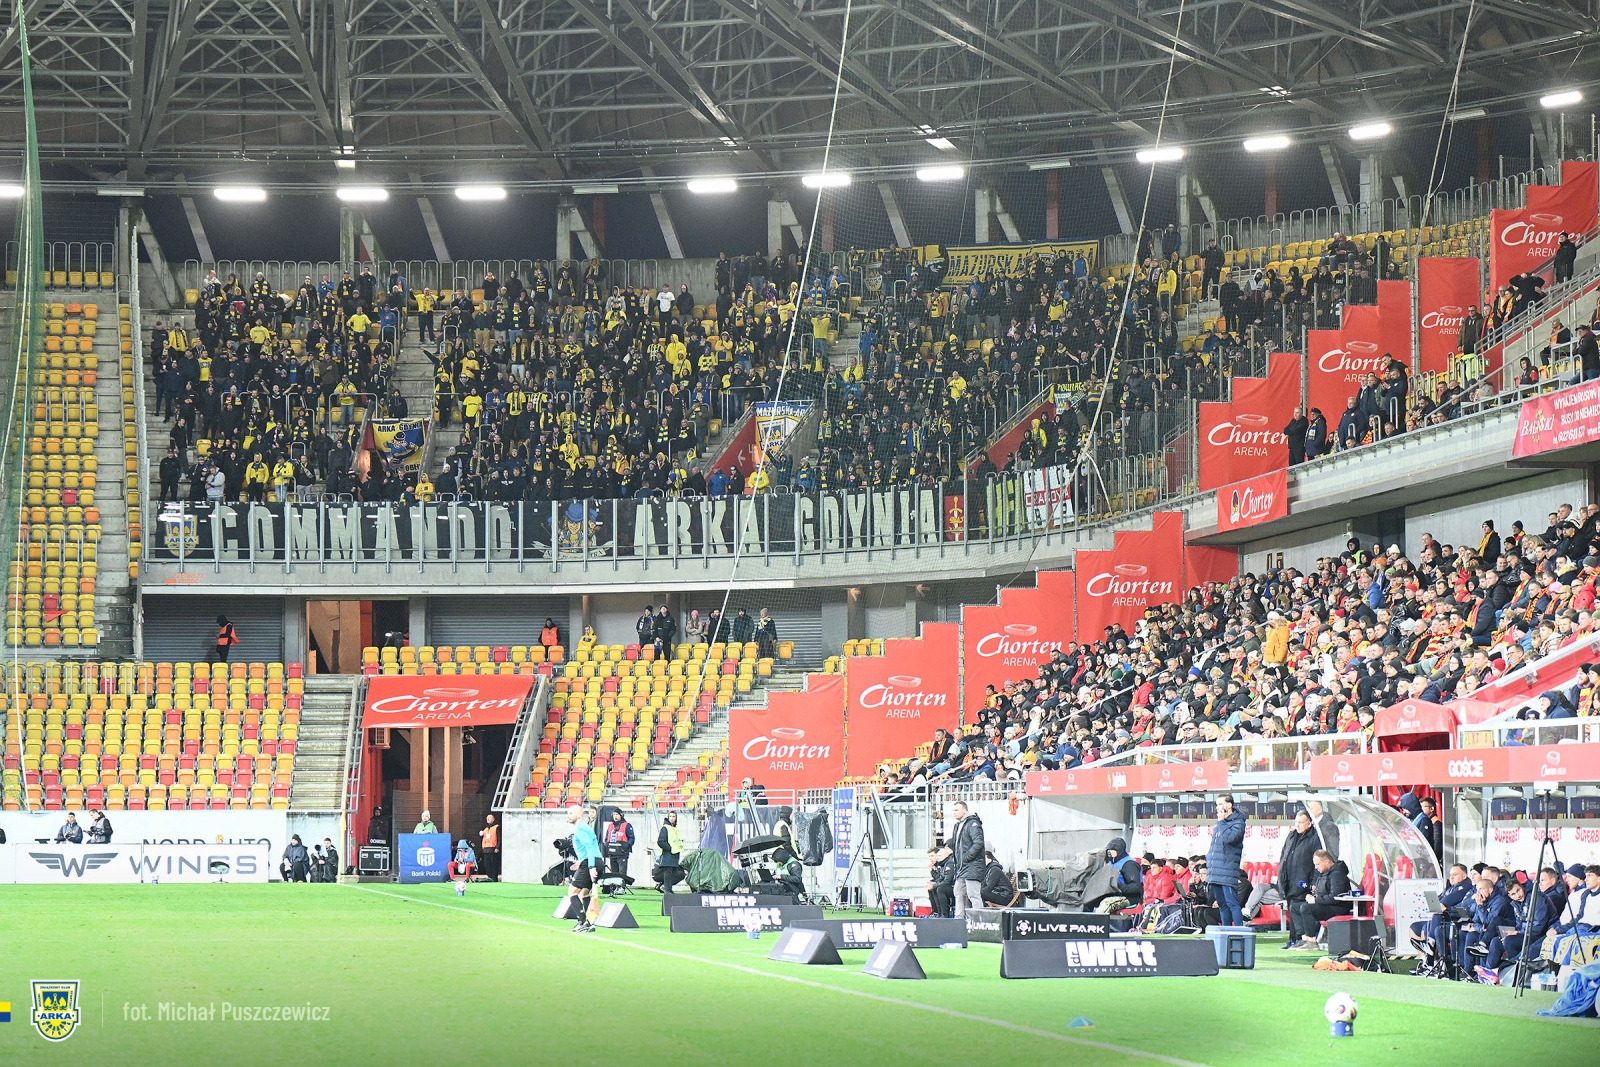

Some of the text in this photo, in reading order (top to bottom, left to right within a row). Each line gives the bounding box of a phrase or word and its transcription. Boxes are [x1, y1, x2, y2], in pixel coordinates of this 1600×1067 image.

[1527, 247, 1556, 257] AREN
[1421, 311, 1465, 329] Chort
[1318, 348, 1386, 373] Chort
[1344, 373, 1367, 383] ARE
[378, 424, 396, 433] ARKA
[1207, 421, 1289, 446] Chorten
[1233, 447, 1268, 457] ARENA
[1240, 486, 1274, 519] Chorten
[633, 499, 762, 558] ARKA
[798, 489, 939, 552] GDYNIA
[1086, 572, 1173, 597] Chorten
[1112, 597, 1147, 607] ARENA
[976, 632, 1063, 657] Chorten
[1002, 657, 1038, 667] ARENA
[370, 694, 519, 714] Chorten
[859, 683, 947, 708] Chorten
[411, 711, 472, 721] ARENA
[885, 709, 921, 718] ARENA
[742, 736, 830, 760] Chorten
[768, 761, 805, 771] ARENA
[1448, 756, 1484, 778] GOŚCIE
[1494, 827, 1521, 844] SUPERBET
[1575, 826, 1600, 844] SUPERB
[129, 855, 257, 875] WINGS
[851, 921, 918, 943] Witt
[1038, 923, 1105, 934] LIVE PARK
[1076, 940, 1158, 967] Witt
